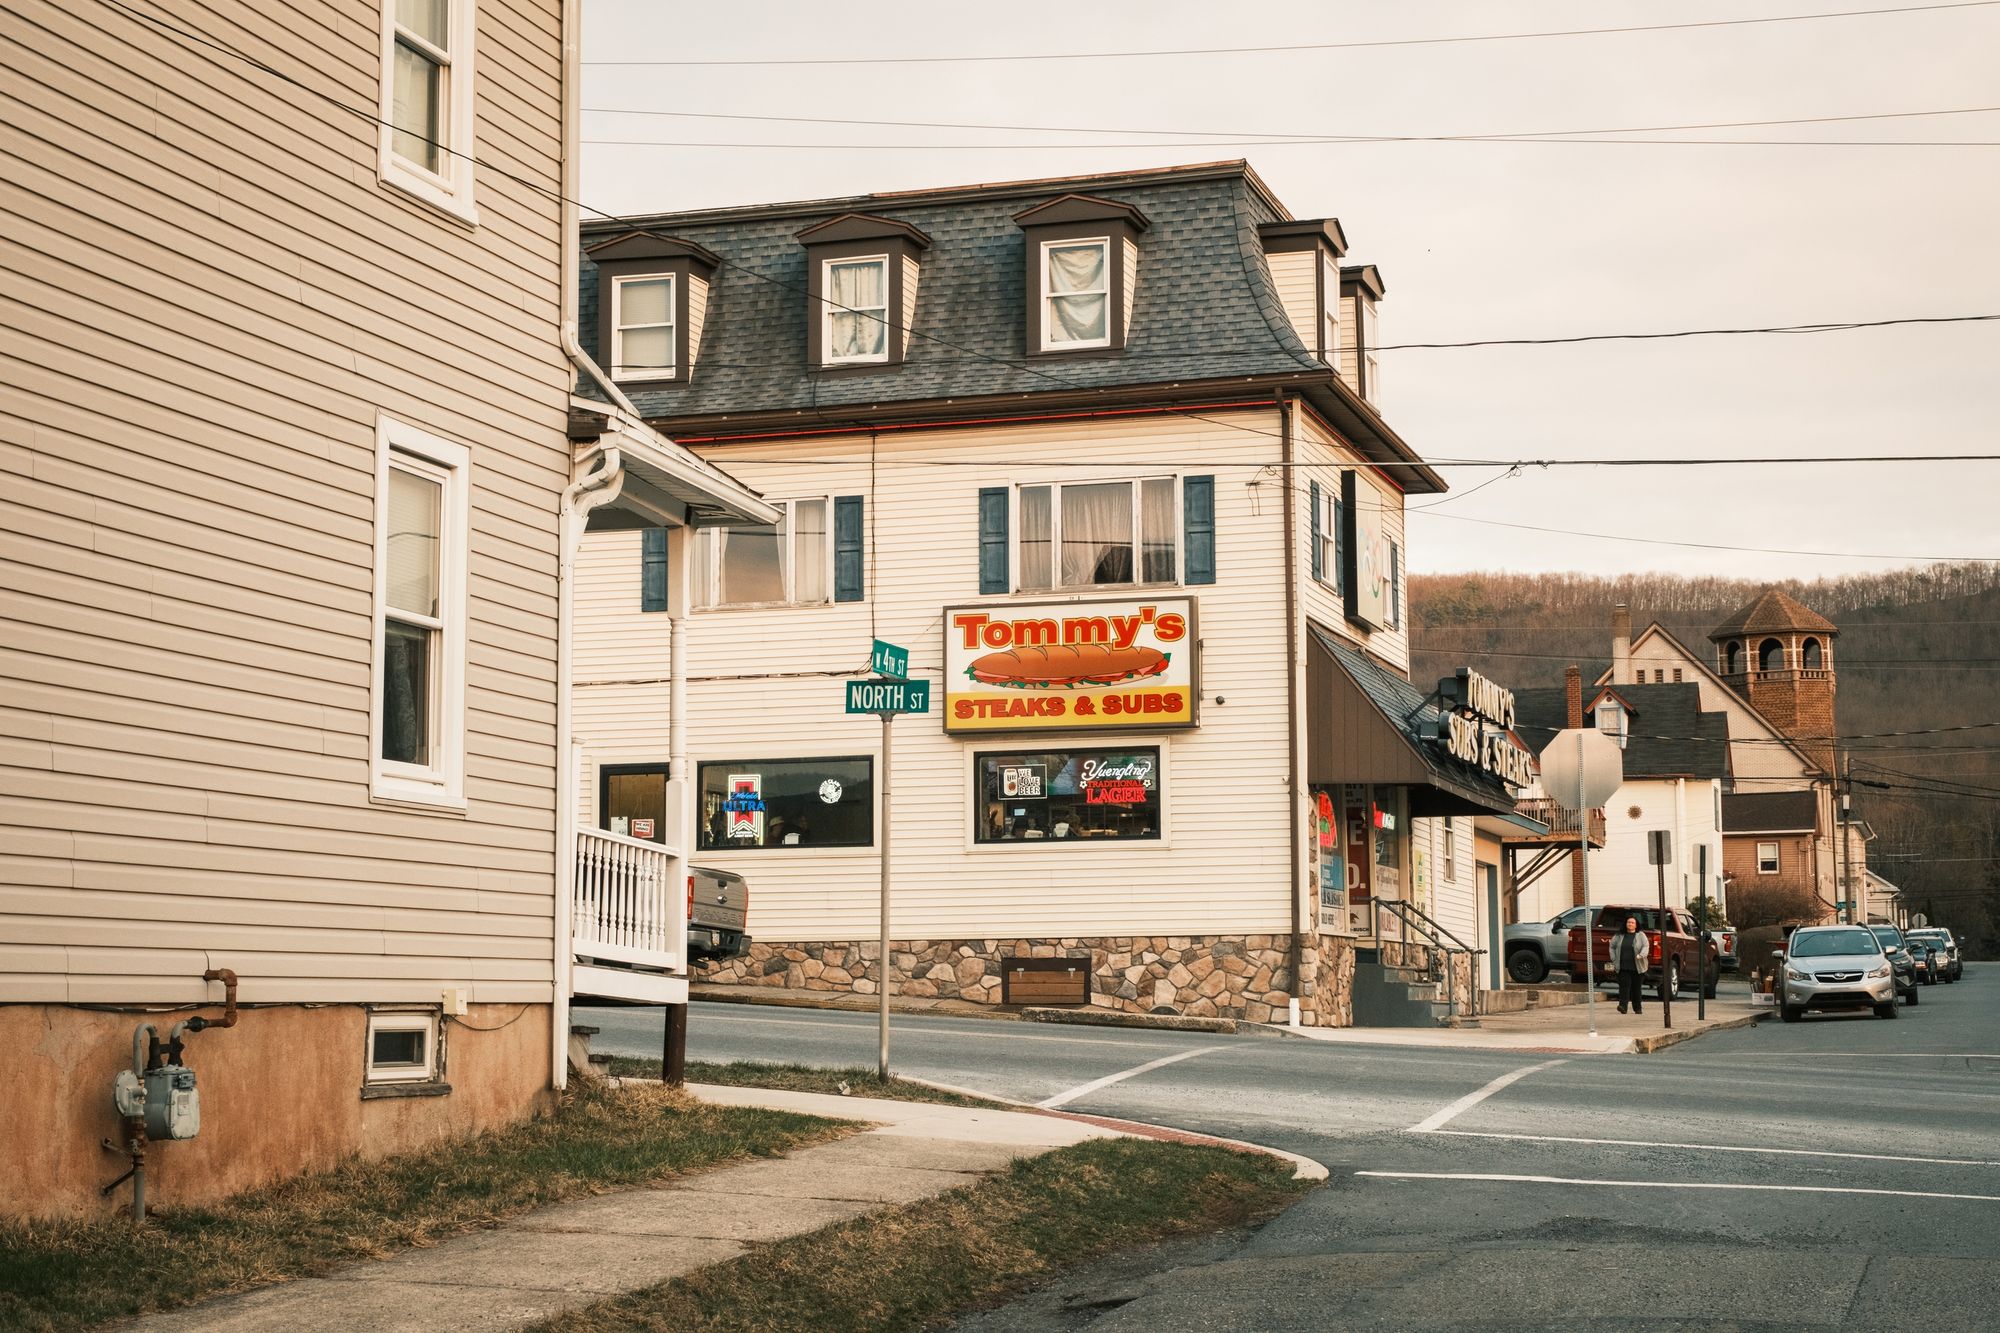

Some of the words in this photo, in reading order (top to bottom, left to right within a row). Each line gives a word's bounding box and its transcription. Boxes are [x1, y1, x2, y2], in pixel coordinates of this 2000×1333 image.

[953, 606, 1186, 650] Tommy's
[883, 648, 895, 672] 4TH
[897, 659, 905, 675] ST
[851, 685, 904, 709] NORTH
[910, 693, 923, 709] ST
[955, 696, 1066, 720] STEAKS
[1073, 695, 1096, 716] &
[1102, 693, 1184, 716] SUBS
[1468, 667, 1515, 731] TOMMY'S
[1448, 712, 1479, 764] SUBS
[1482, 731, 1491, 771] &
[1494, 736, 1533, 787] STEAKS
[1018, 768, 1032, 777] WE
[1081, 760, 1152, 781] Yuengling
[1018, 777, 1041, 786] LOVE
[1018, 786, 1041, 795] BEER
[1087, 780, 1145, 788] TRADITIONAL
[723, 800, 766, 812] ULTRA
[1086, 787, 1147, 804] LAGER
